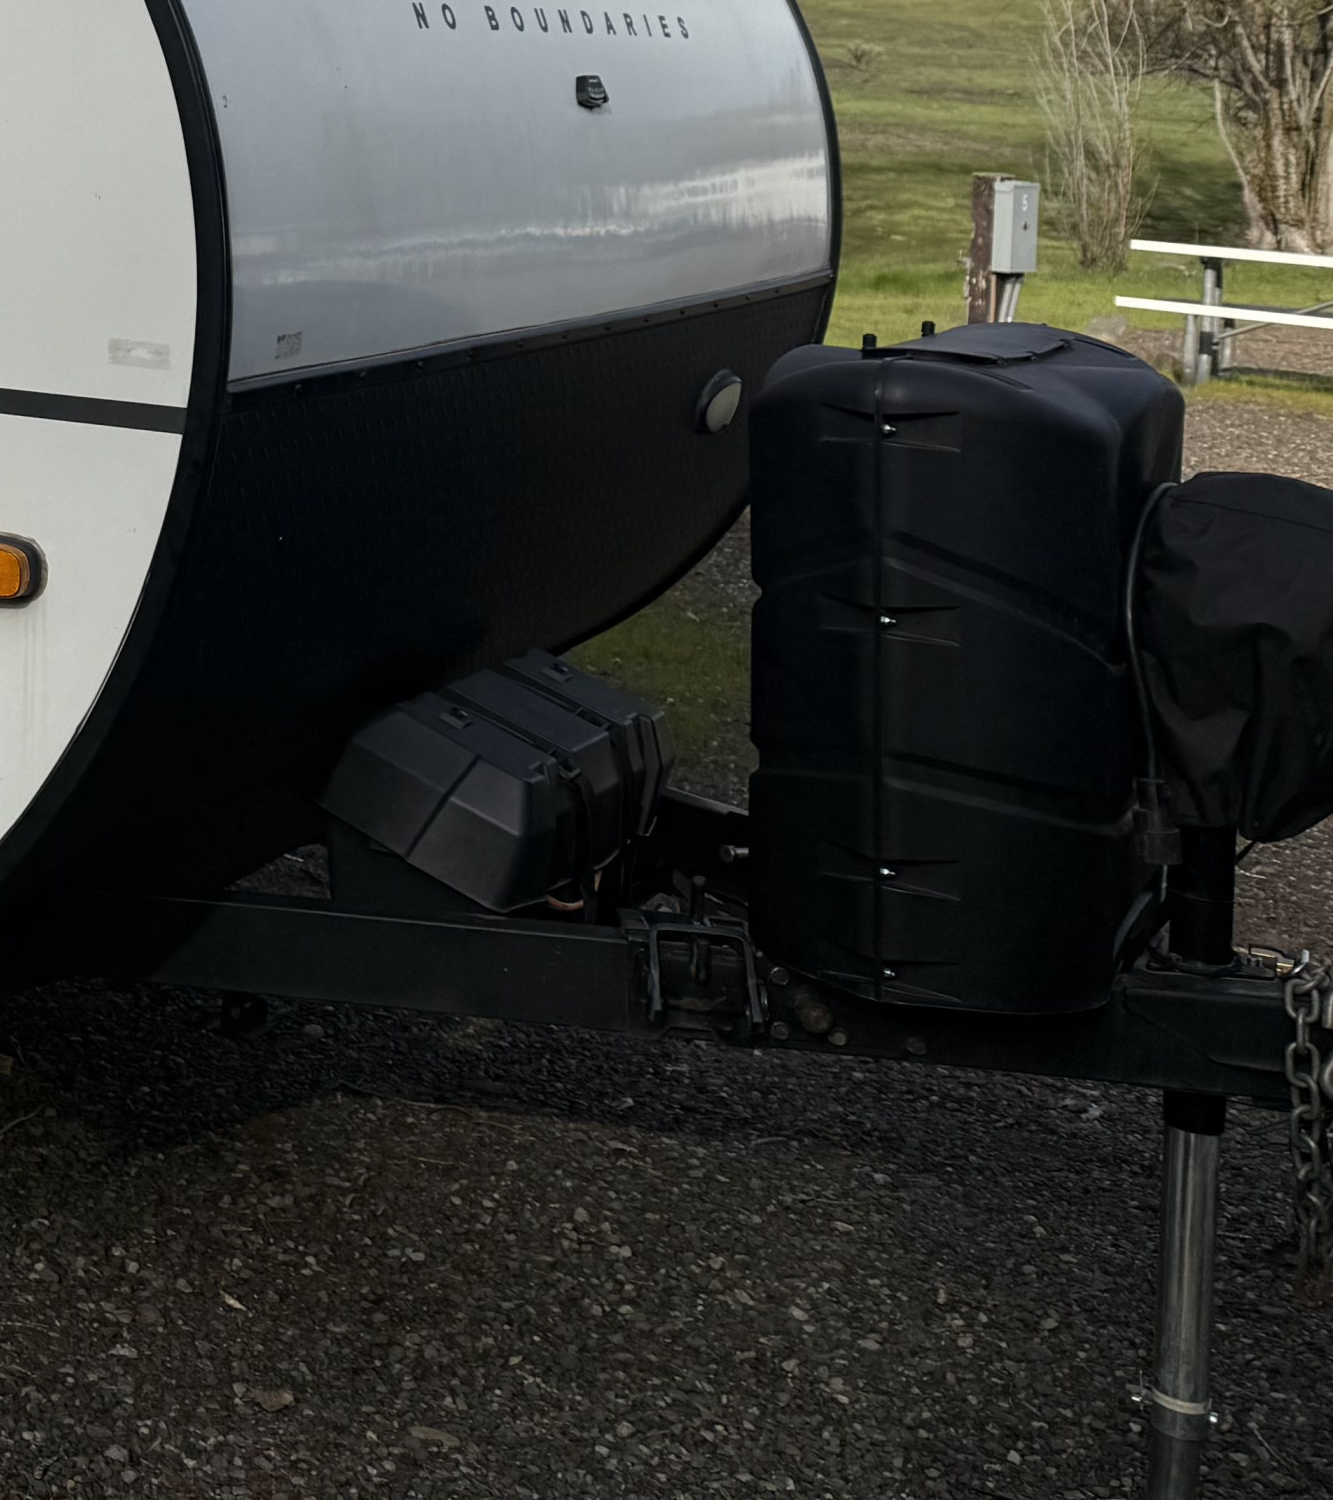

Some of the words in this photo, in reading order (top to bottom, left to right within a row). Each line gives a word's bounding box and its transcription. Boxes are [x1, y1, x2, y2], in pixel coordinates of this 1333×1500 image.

[412, 2, 457, 30] NO
[484, 5, 689, 39] BOUNDARIES
[1021, 193, 1029, 212] 5
